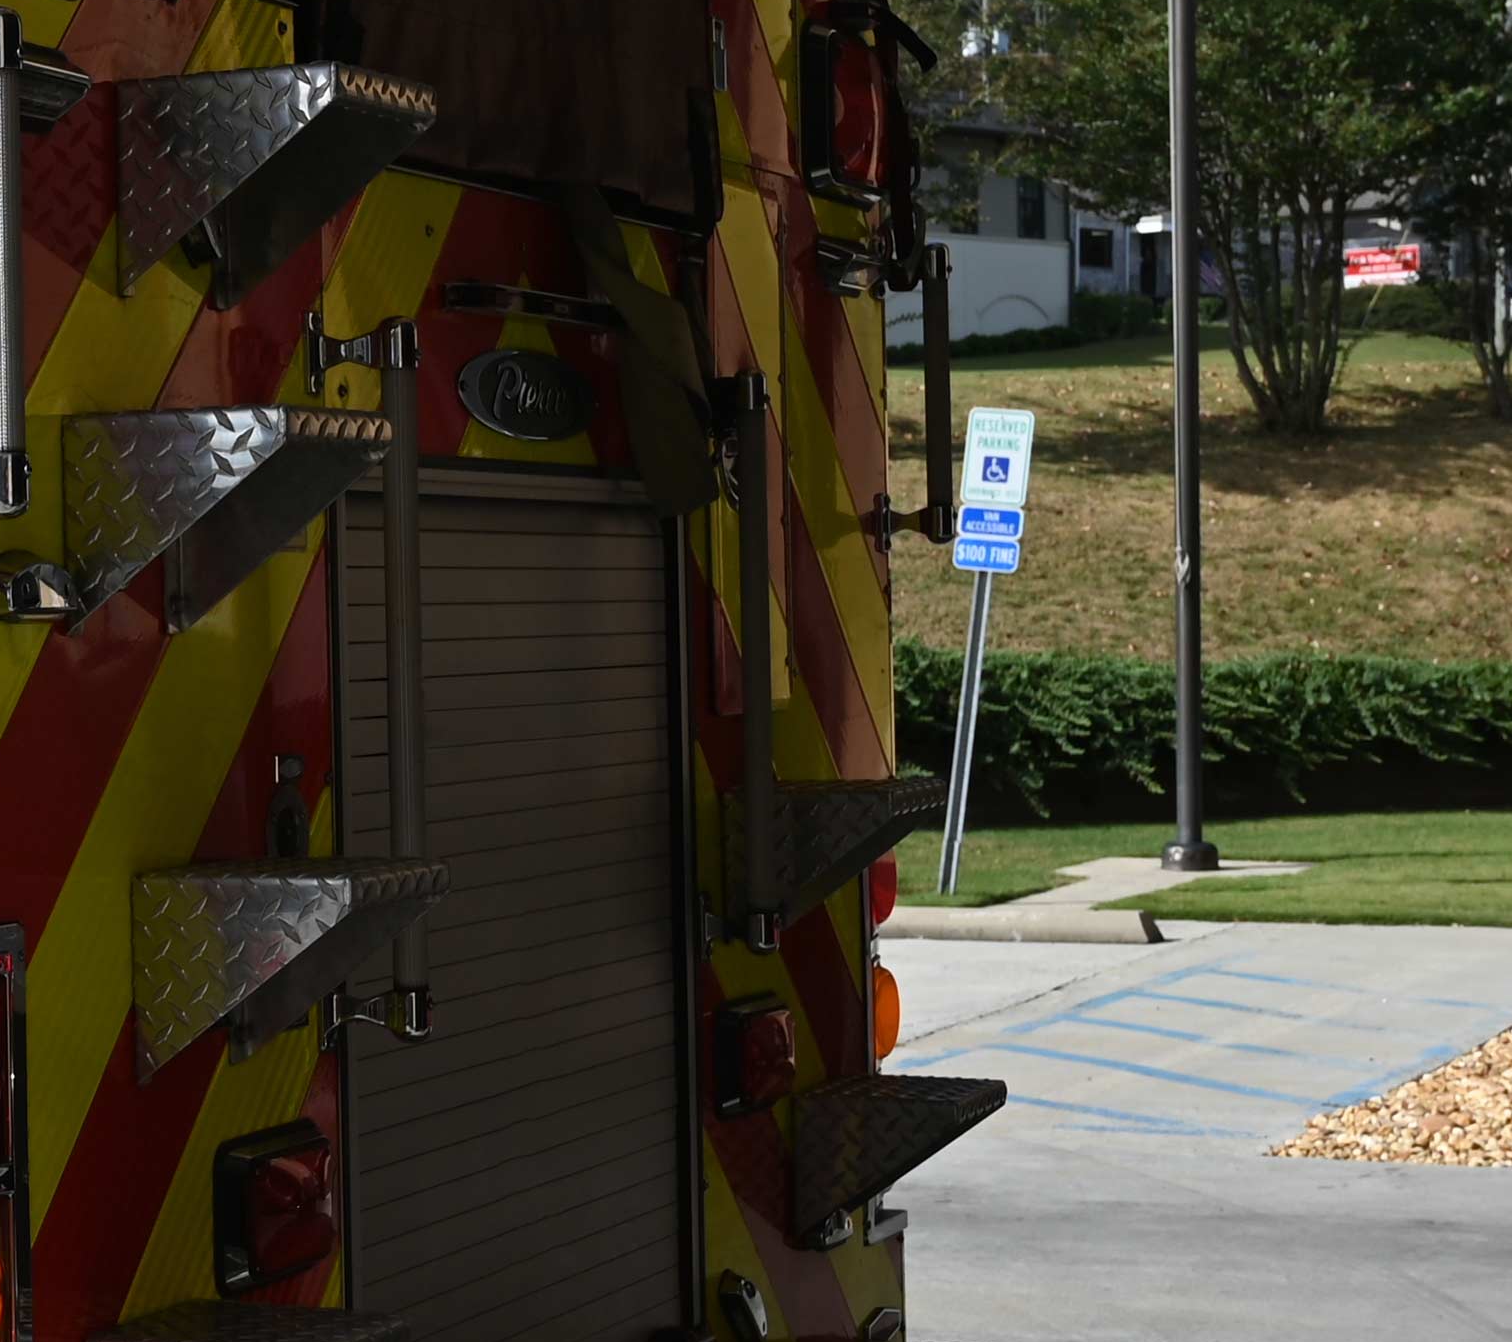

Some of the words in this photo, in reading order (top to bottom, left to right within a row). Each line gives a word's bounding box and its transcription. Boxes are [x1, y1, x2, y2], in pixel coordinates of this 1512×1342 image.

[975, 419, 1027, 435] RESERVED
[977, 436, 1020, 451] PARKING
[965, 520, 1015, 535] ACCESSIBLE
[957, 544, 986, 563] $100
[990, 546, 1015, 565] FINE
